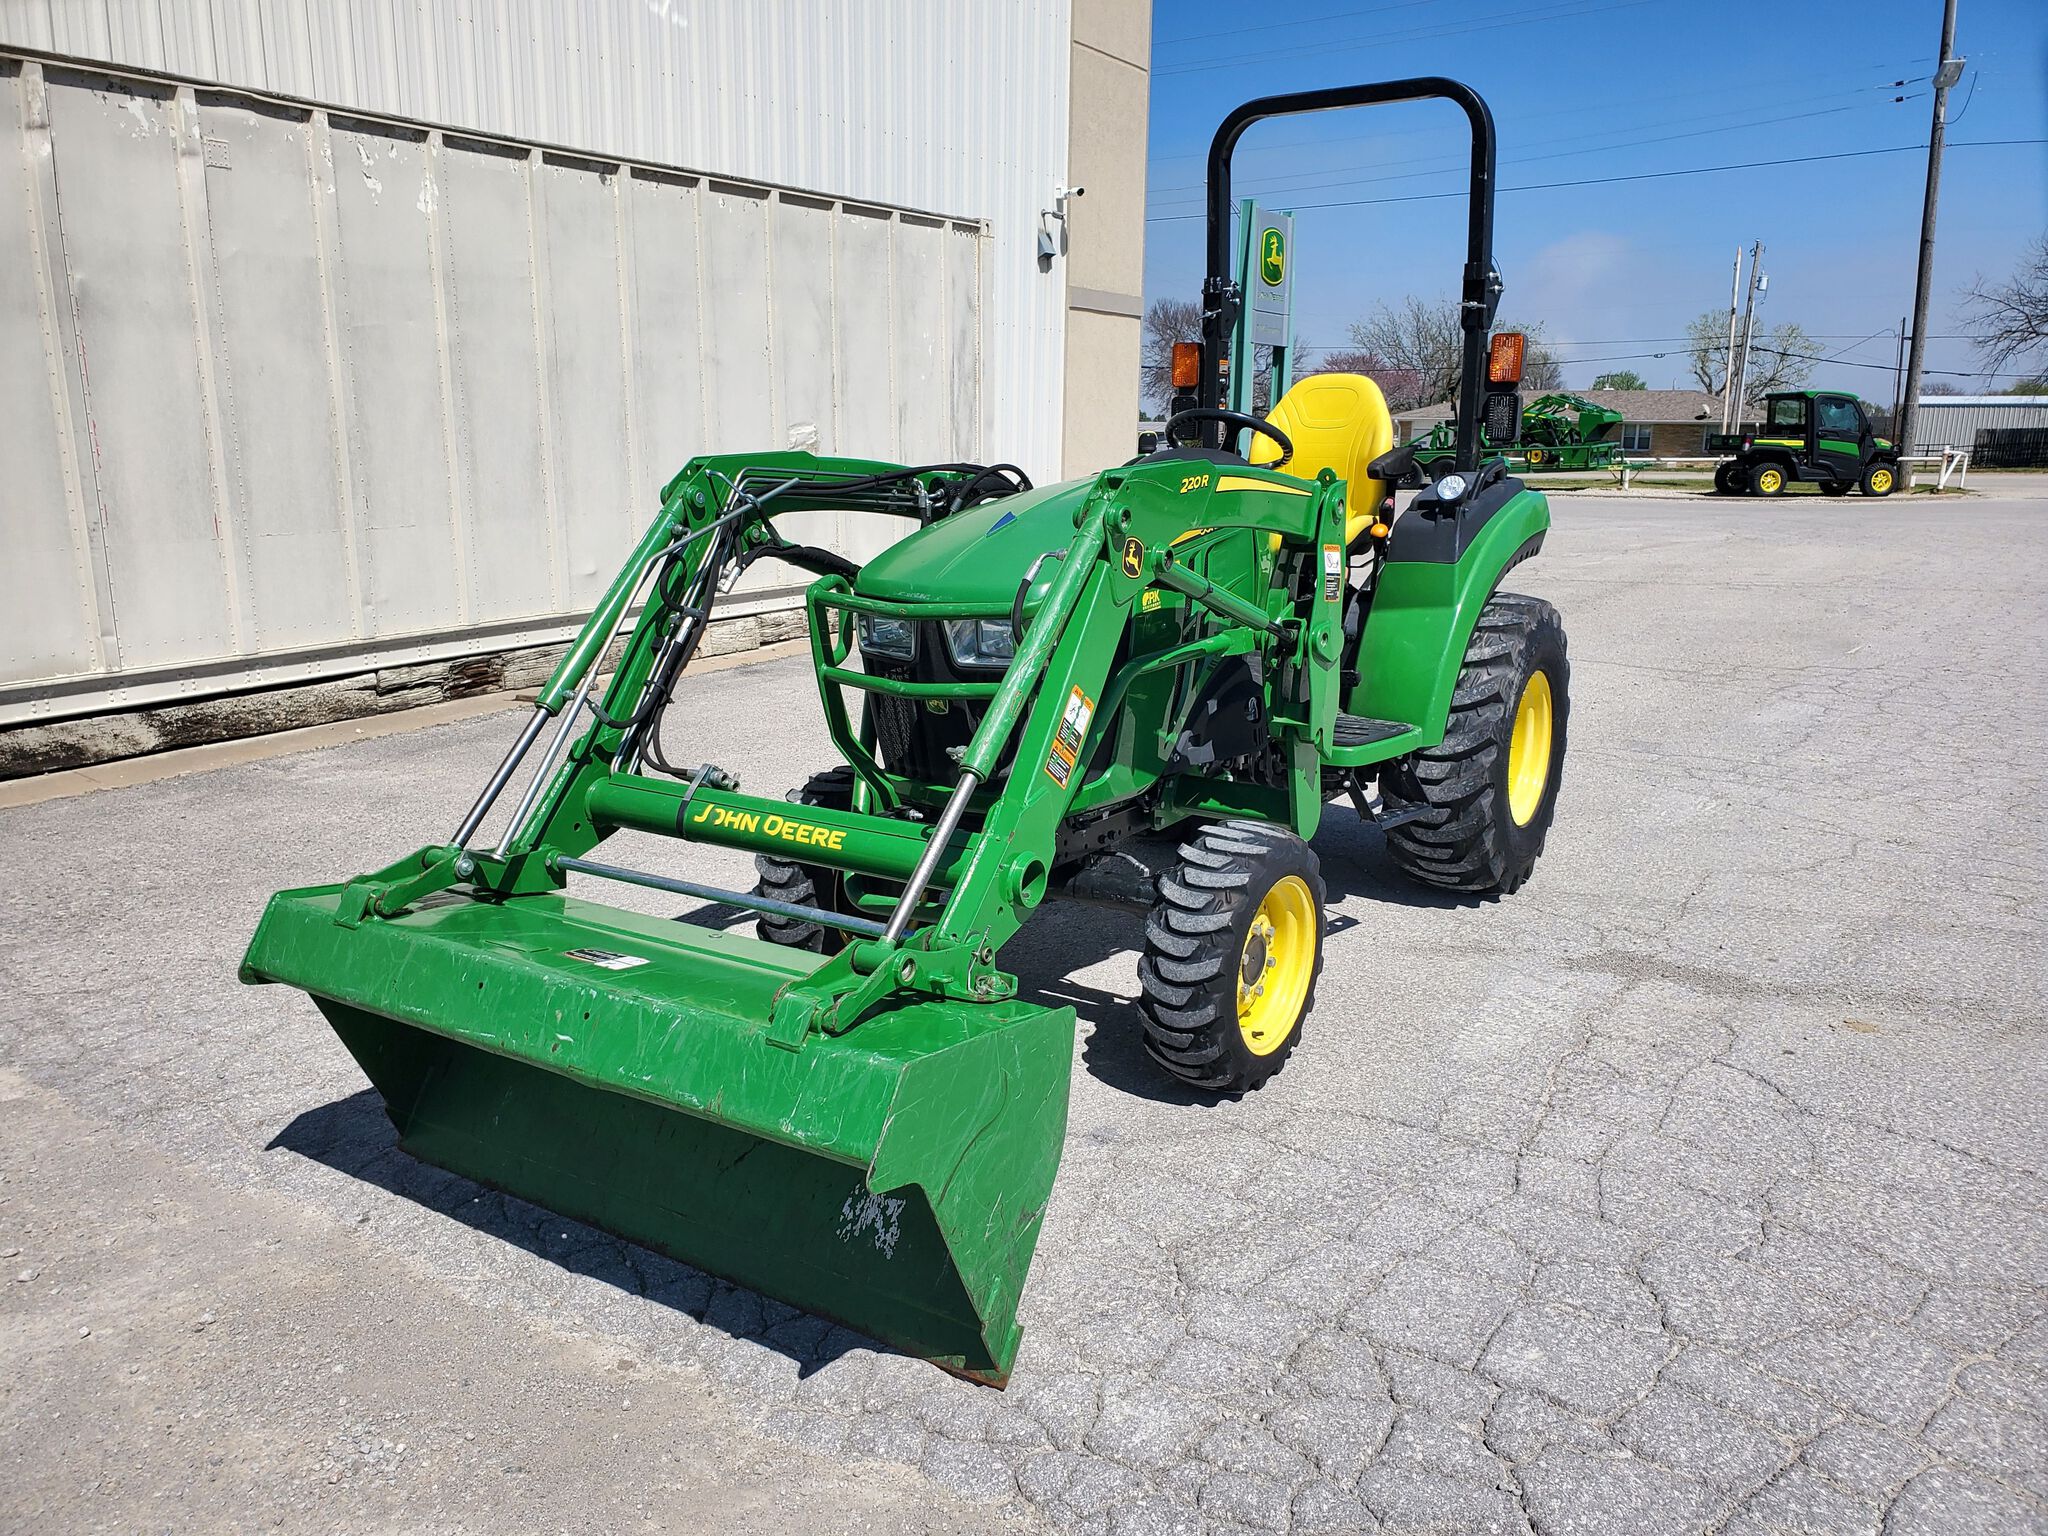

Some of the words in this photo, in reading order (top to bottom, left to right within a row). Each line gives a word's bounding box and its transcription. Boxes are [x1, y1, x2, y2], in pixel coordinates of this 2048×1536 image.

[1180, 475, 1209, 493] 220R
[693, 803, 761, 833] JOHN
[763, 814, 848, 850] DEERE
